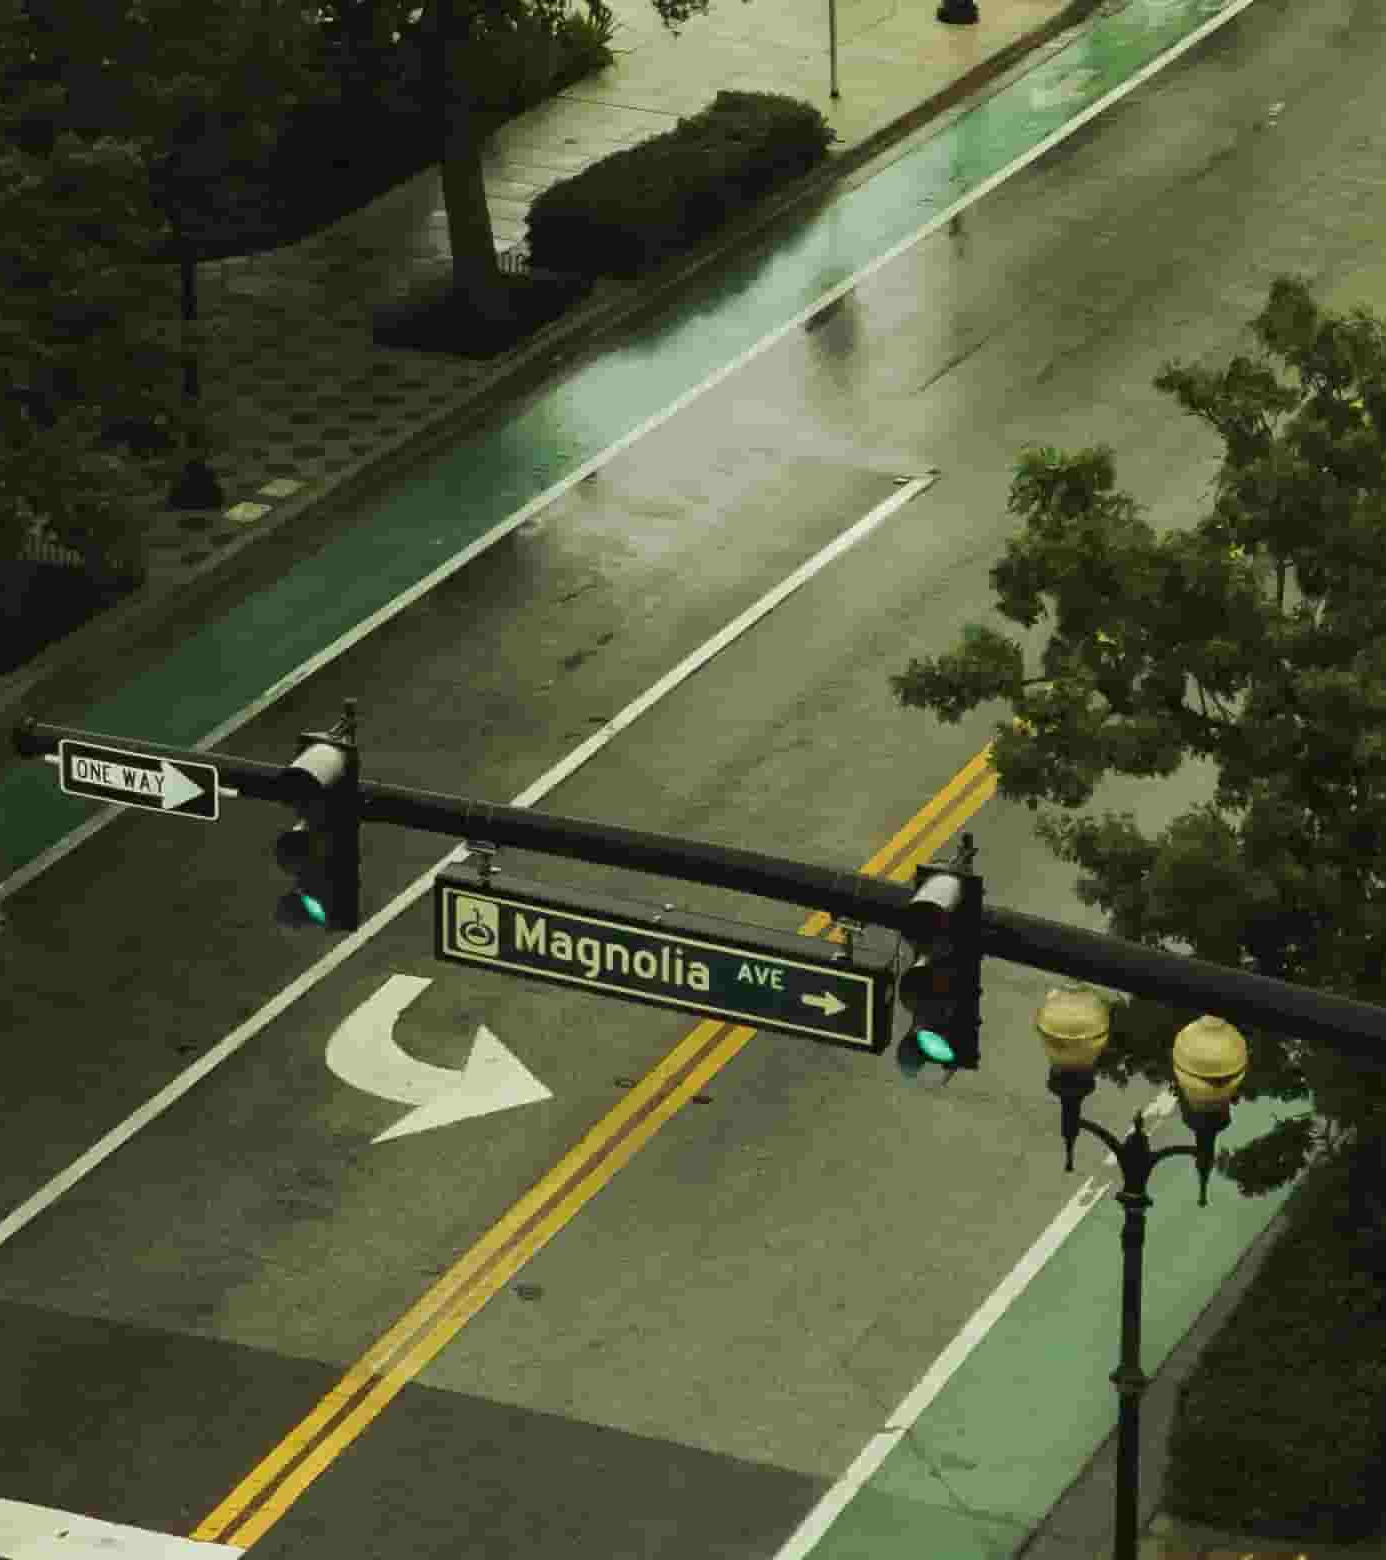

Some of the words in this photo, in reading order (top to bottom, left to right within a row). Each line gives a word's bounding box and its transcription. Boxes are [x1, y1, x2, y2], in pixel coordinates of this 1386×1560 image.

[76, 759, 112, 784] ONE
[123, 767, 166, 794] WAY
[514, 911, 710, 992] Magnolia
[737, 961, 788, 991] AVE
